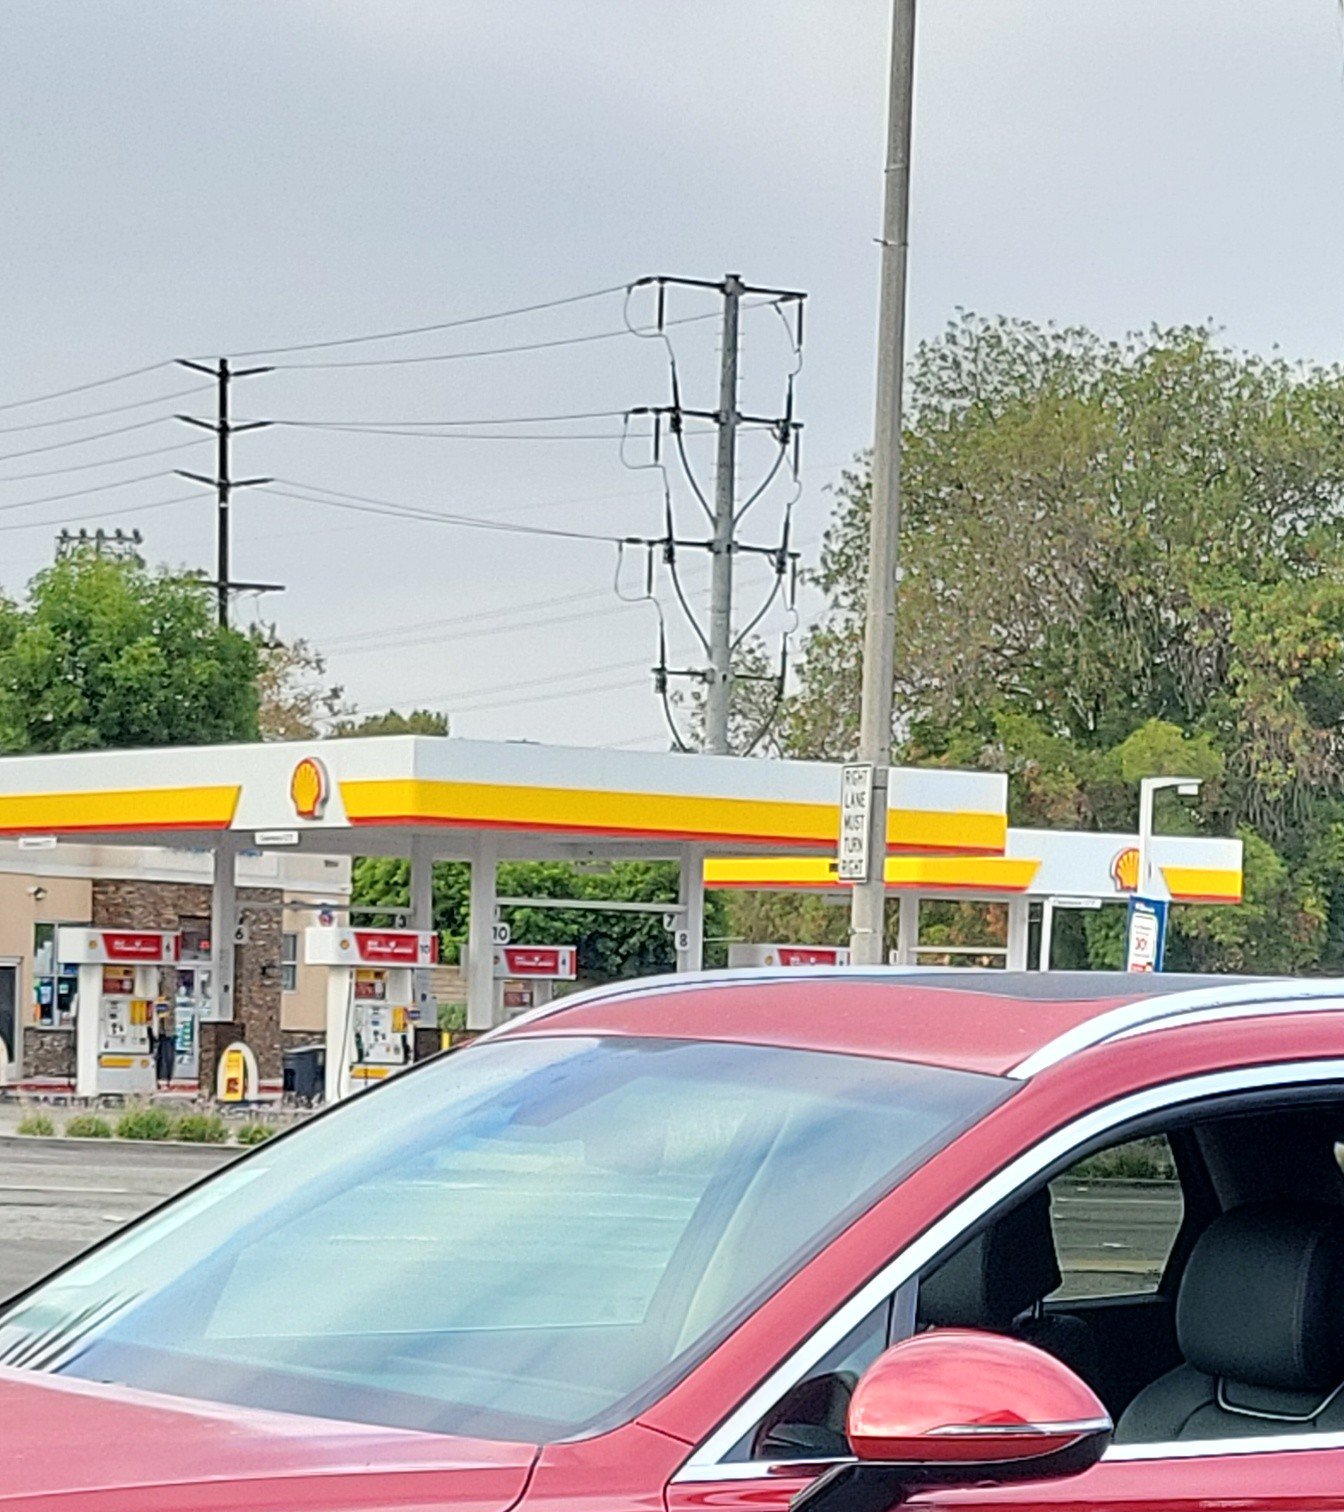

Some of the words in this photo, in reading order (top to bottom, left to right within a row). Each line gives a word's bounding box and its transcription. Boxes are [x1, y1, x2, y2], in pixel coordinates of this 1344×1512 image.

[844, 769, 868, 786] RIGHT
[844, 791, 866, 809] LANE
[844, 814, 865, 831] MUST
[843, 836, 864, 853] TURN
[841, 859, 864, 875] RIGHT
[235, 927, 244, 940] 6
[492, 926, 508, 941] 10
[679, 932, 688, 947] 8
